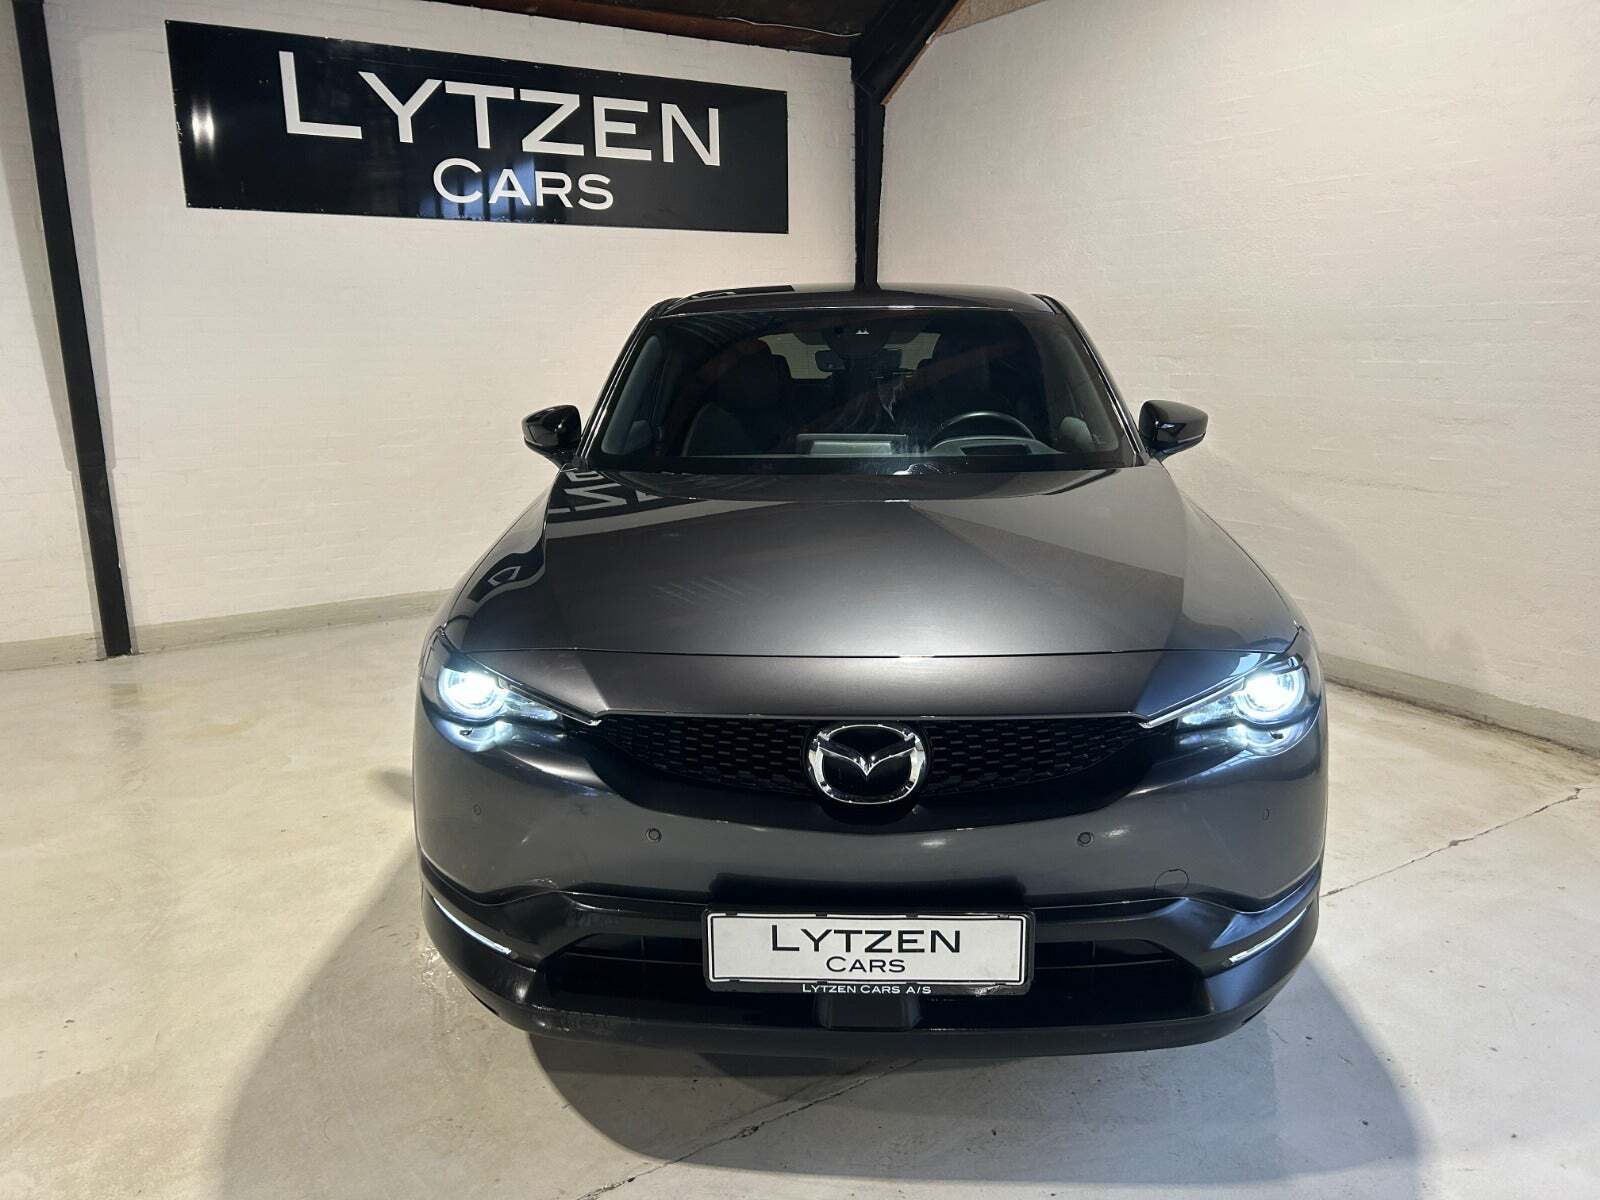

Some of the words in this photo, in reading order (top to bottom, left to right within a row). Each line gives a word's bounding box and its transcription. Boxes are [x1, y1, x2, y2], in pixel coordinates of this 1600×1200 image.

[278, 50, 721, 167] LYTZEN
[432, 158, 614, 211] CARS
[771, 924, 961, 953] LYTZEN
[826, 955, 906, 973] CARS
[802, 983, 856, 993] LYTZEN
[860, 984, 901, 994] CARS
[905, 984, 932, 995] A/S
